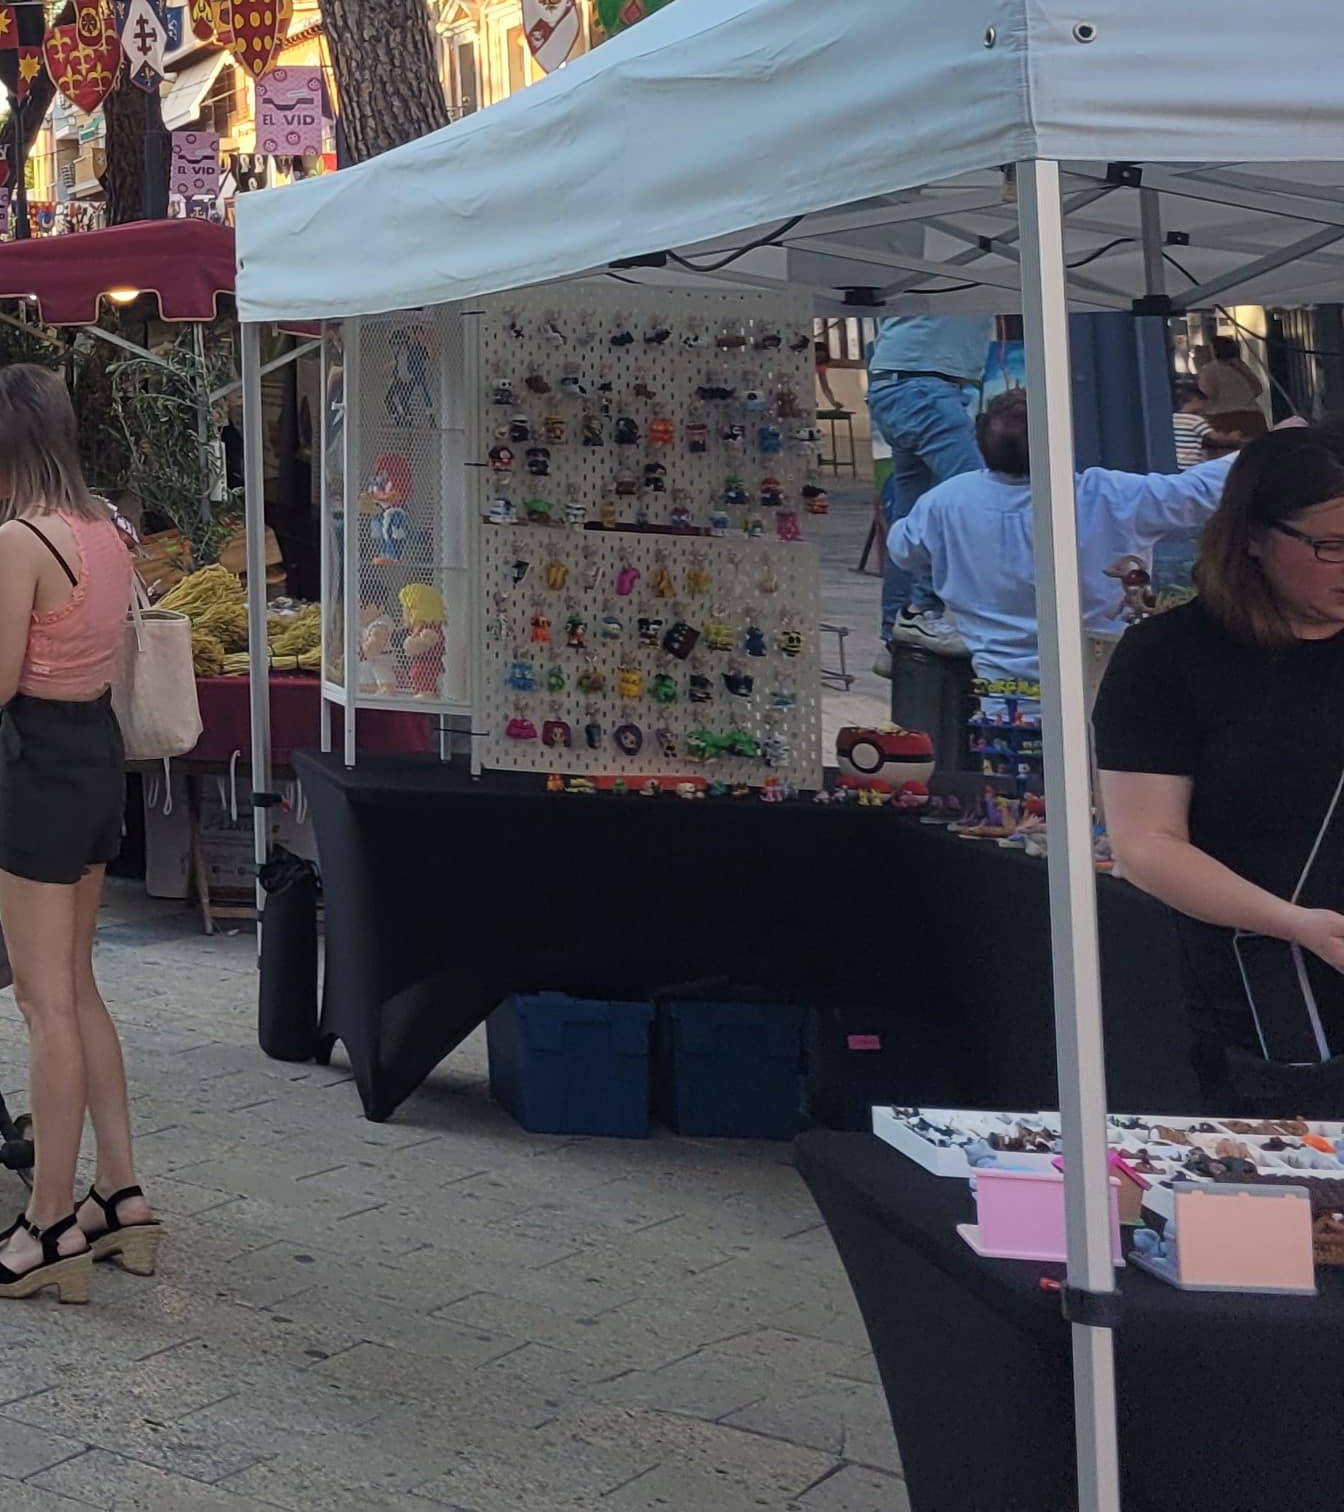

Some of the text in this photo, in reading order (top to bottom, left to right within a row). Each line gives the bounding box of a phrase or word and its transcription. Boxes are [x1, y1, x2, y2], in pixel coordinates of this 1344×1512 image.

[263, 114, 315, 126] EL VID
[192, 166, 215, 175] VID
